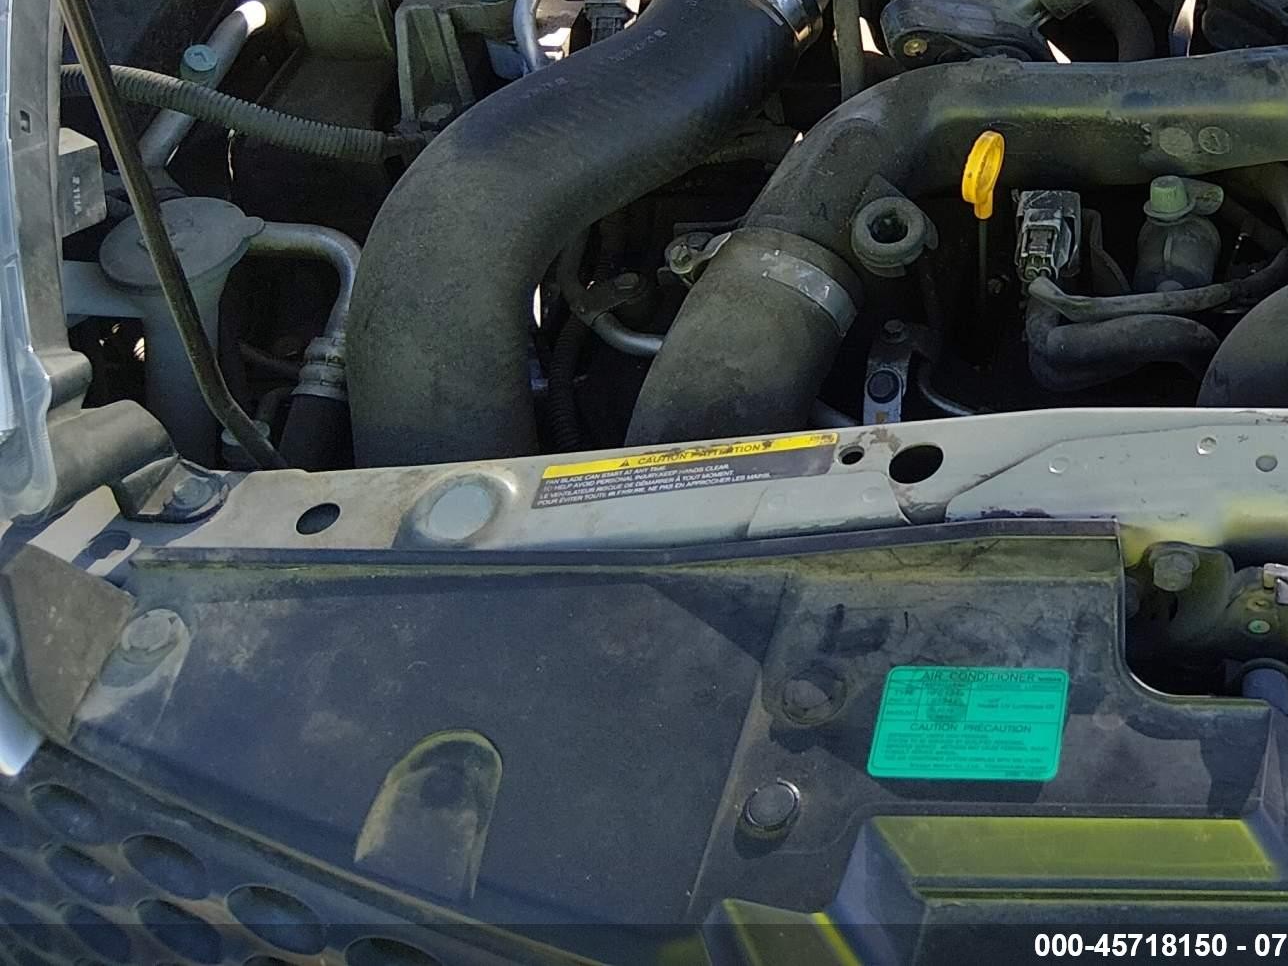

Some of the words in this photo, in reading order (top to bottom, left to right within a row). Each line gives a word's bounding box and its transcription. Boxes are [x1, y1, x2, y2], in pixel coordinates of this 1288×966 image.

[637, 452, 687, 465] CAUTION
[584, 473, 600, 481] CAN
[601, 470, 623, 479] START
[634, 467, 649, 475] ANY
[682, 473, 702, 482] TOUT
[732, 474, 746, 483] LES
[554, 482, 573, 491] HELP
[573, 480, 596, 489] AVOID
[922, 671, 943, 682] AIR
[949, 671, 1037, 683] CONDITIONER
[910, 722, 959, 731] CAUTION
